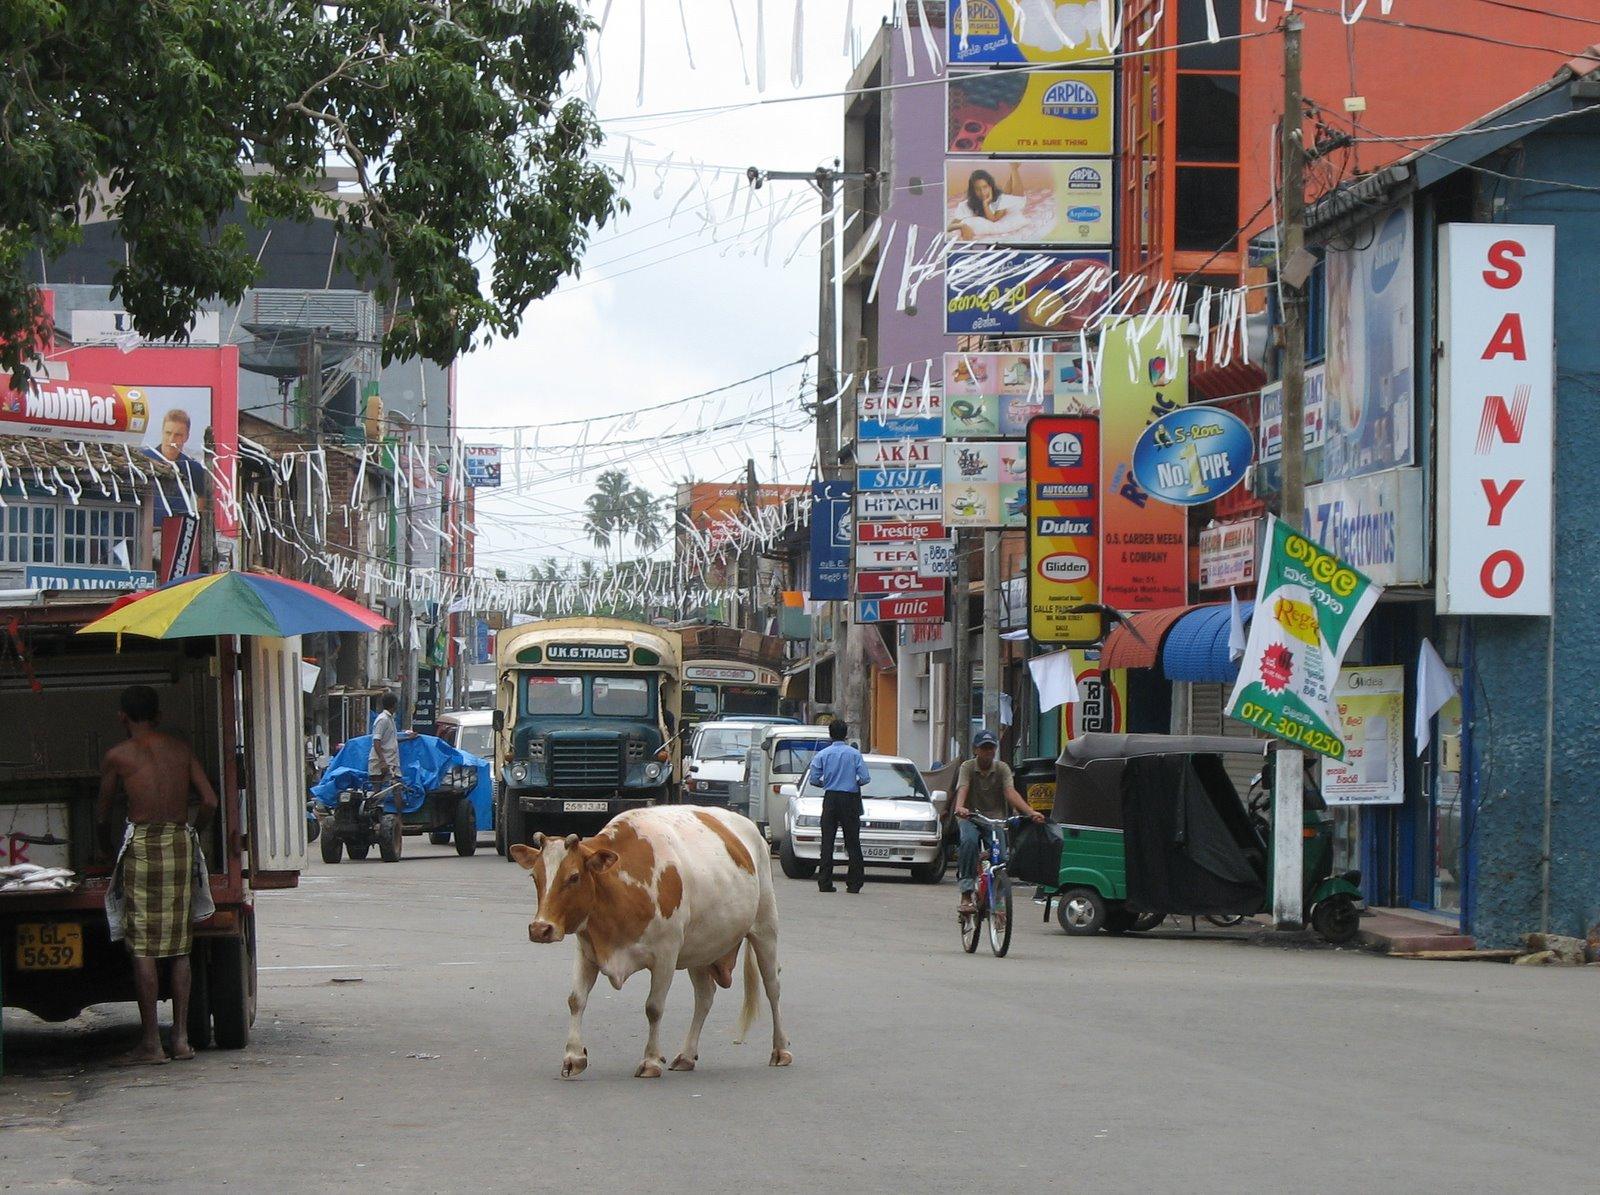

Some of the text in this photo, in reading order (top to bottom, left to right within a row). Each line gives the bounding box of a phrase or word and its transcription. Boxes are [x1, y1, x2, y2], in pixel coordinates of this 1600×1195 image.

[1046, 84, 1093, 103] ARPICO
[25, 377, 117, 426] Multilac
[1475, 239, 1532, 599] SANYO
[875, 445, 930, 461] AKAI
[1052, 441, 1078, 453] CIC
[1180, 442, 1209, 496] 1
[1201, 452, 1232, 481] PIPE
[873, 470, 932, 488] SISIL
[1042, 484, 1088, 493] AUTOCOLOR
[864, 498, 939, 512] HITACHI
[873, 523, 929, 540] Prestige
[1041, 519, 1089, 534] Dulux
[873, 551, 918, 562] TEFA
[1130, 552, 1168, 563] COMPANY
[1045, 561, 1086, 573] Glidden
[879, 574, 924, 589] TCL
[894, 599, 928, 615] unic
[868, 848, 888, 857] 6082
[24, 947, 74, 966] 5639
